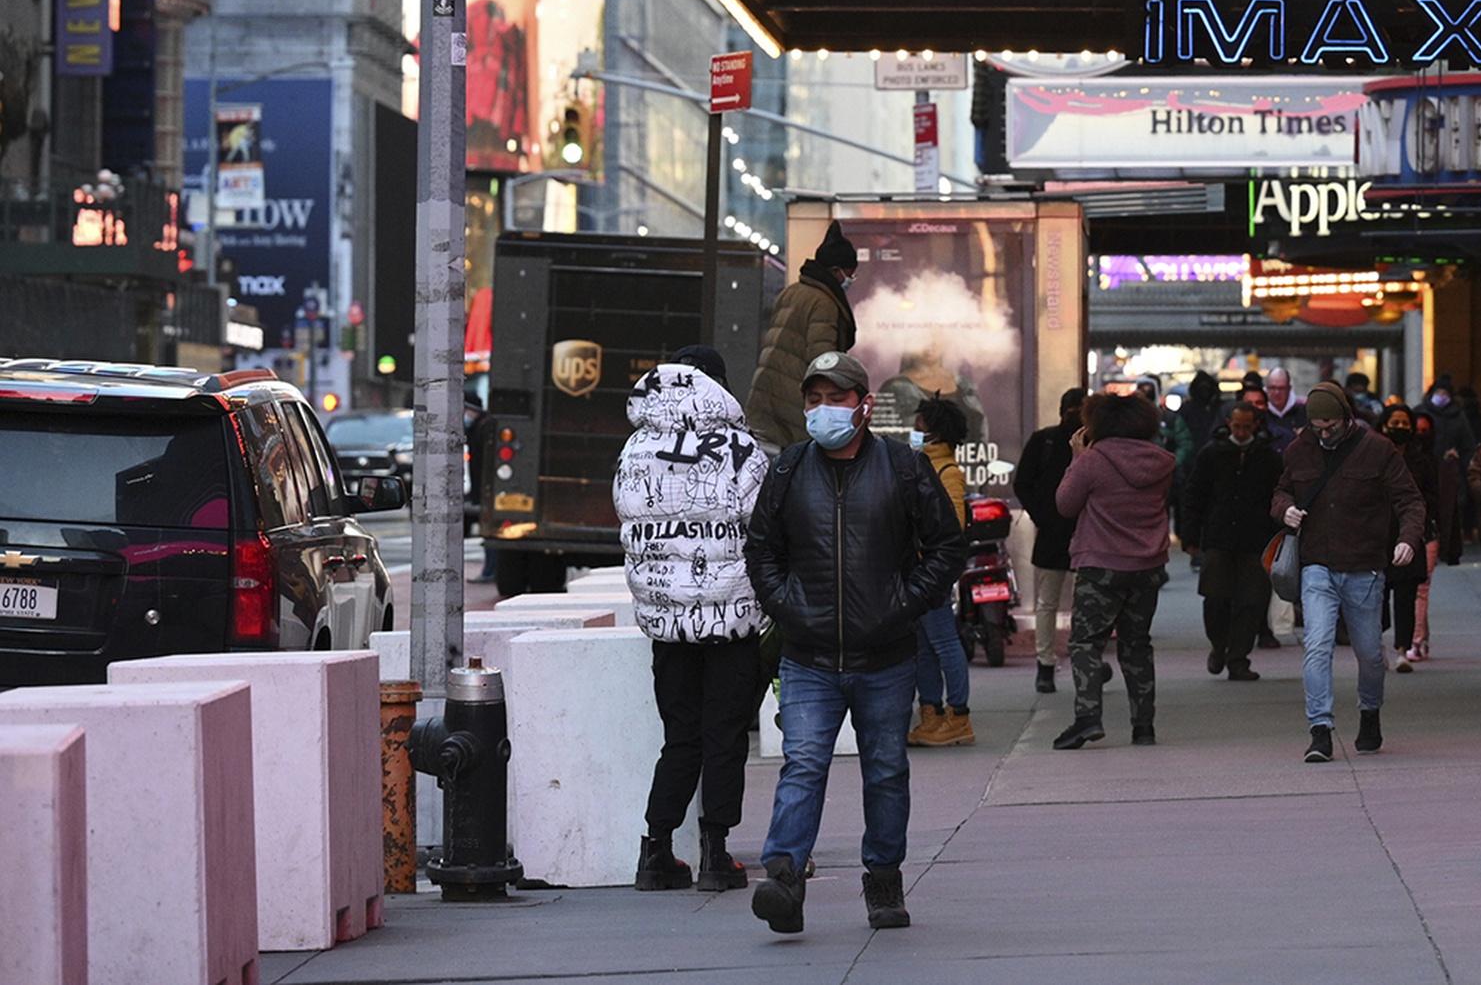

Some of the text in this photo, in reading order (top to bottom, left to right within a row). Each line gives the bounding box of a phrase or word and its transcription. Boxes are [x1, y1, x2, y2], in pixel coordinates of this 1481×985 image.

[1150, 109, 1347, 136] Hilton Times
[908, 223, 957, 233] JCDecaux
[557, 357, 598, 389] ups
[2, 587, 37, 610] 6788
